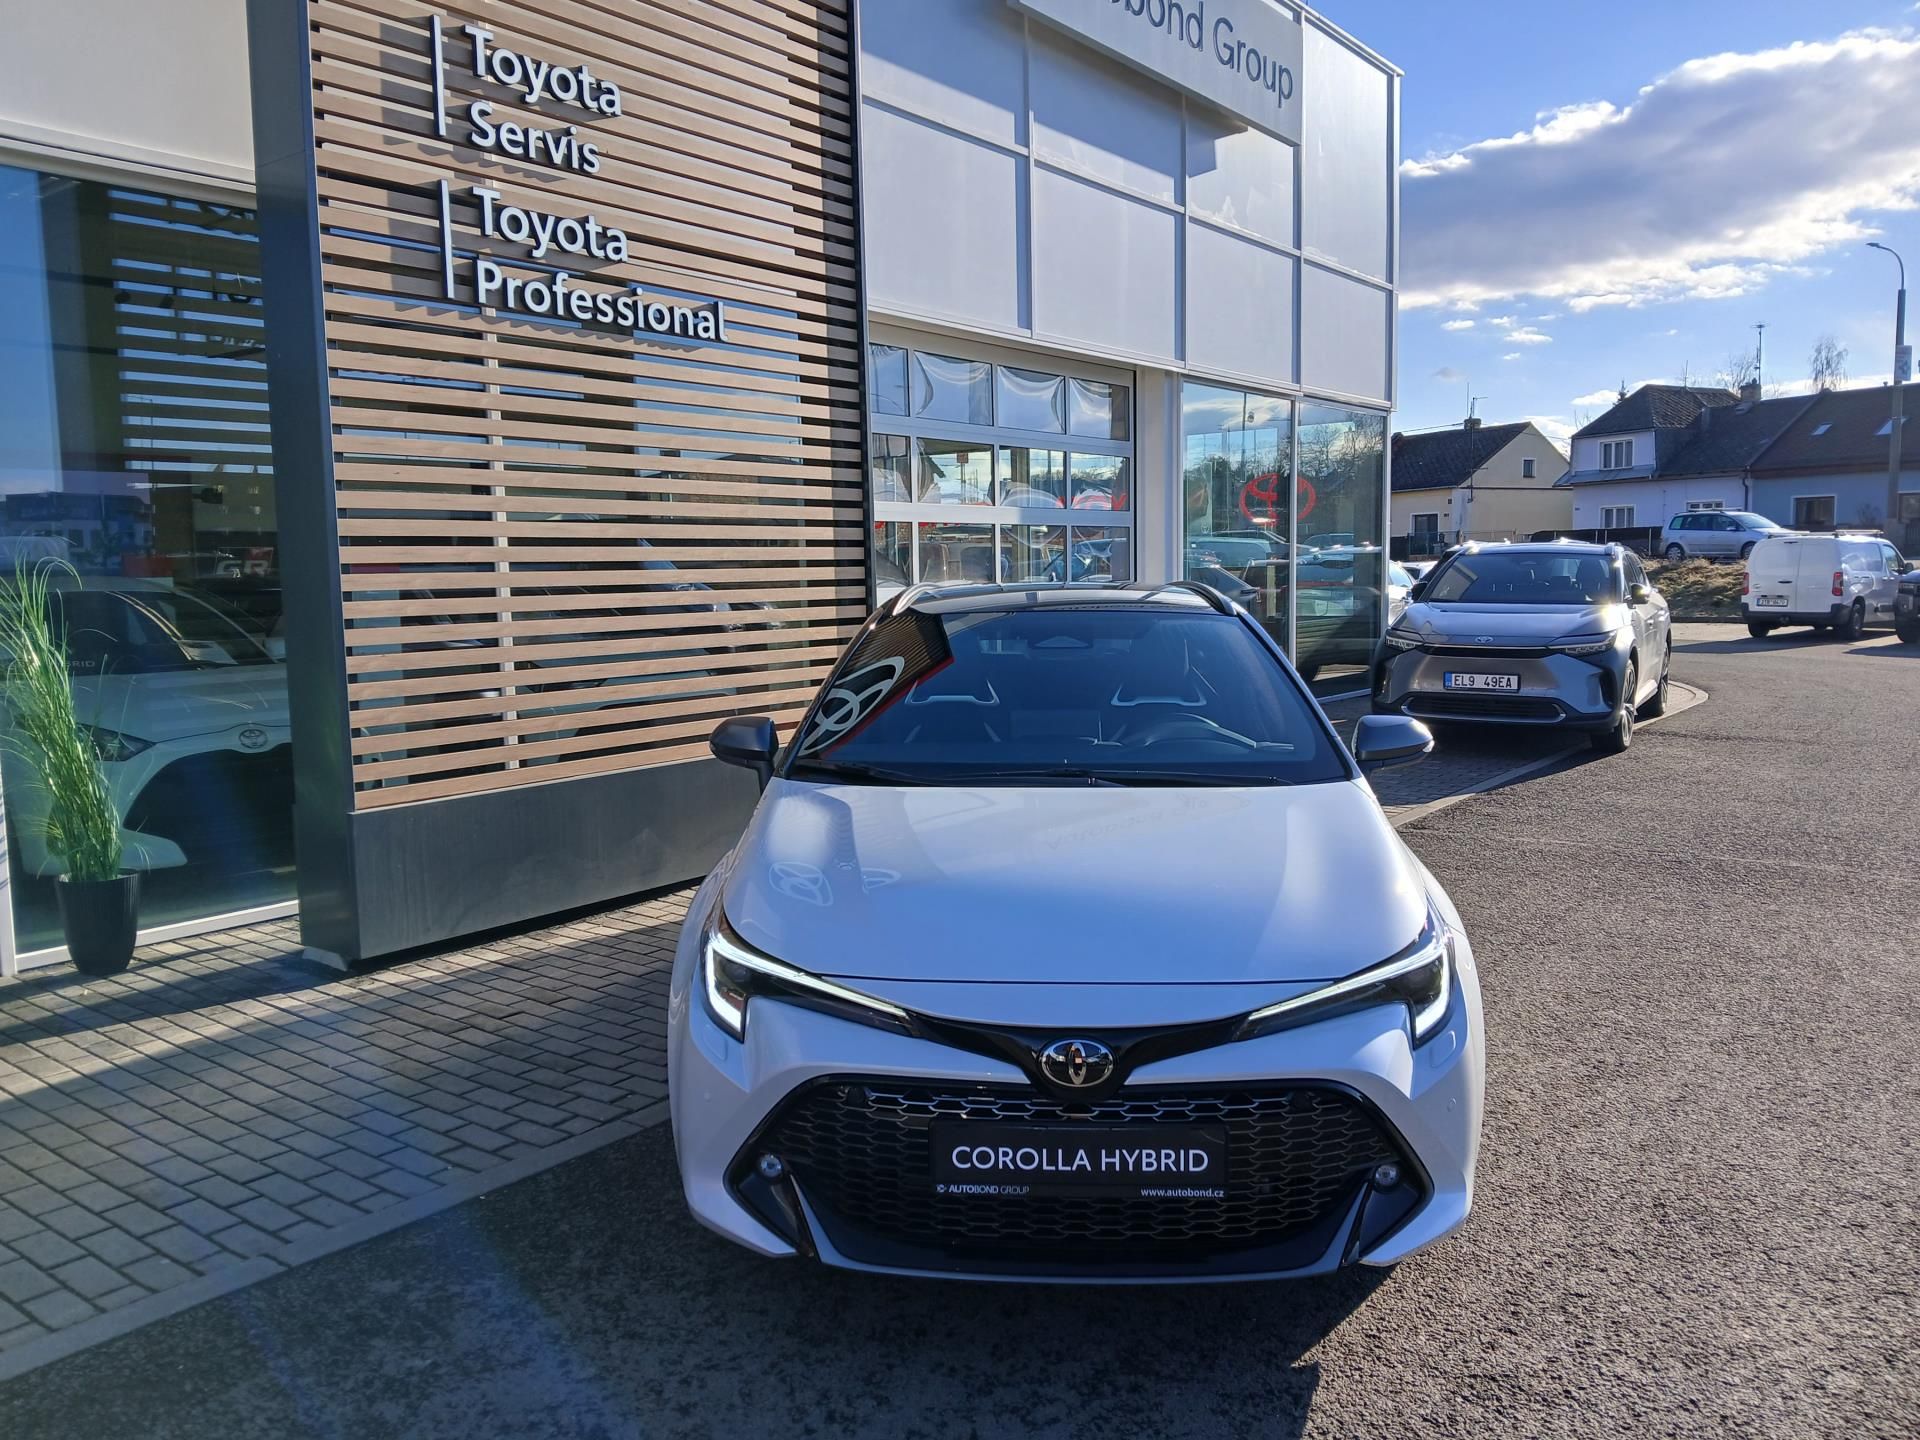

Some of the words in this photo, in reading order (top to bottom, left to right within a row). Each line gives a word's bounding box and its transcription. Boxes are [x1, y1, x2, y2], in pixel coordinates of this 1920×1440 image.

[462, 24, 622, 117] Toyota
[1112, 0, 1204, 52] ond
[1213, 16, 1294, 108] Group
[467, 100, 601, 174] Servis
[472, 186, 628, 263] Toyota
[476, 259, 729, 341] Professional
[1454, 675, 1476, 687] EL9
[1483, 676, 1513, 689] 49EA
[948, 1184, 999, 1194] AUTOBOND
[1000, 1185, 1030, 1194] GROUP
[1140, 1187, 1225, 1198] www.autobond.cz
[951, 1146, 1092, 1171] COROLLA
[1100, 1149, 1209, 1172] HYBRID
